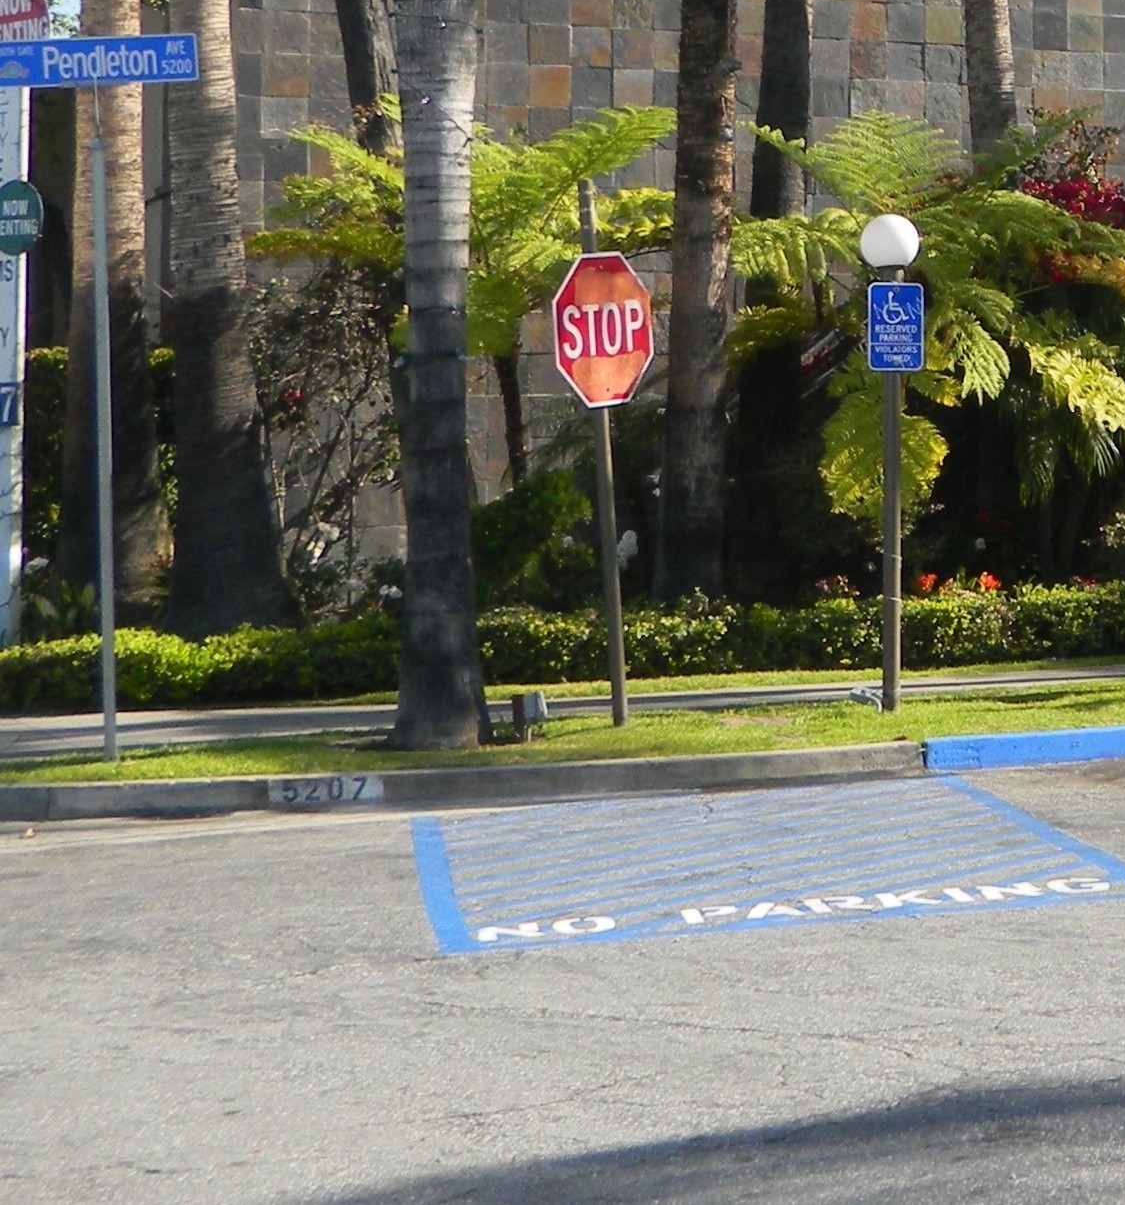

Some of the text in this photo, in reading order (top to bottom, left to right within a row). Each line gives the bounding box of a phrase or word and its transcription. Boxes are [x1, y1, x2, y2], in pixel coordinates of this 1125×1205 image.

[165, 40, 186, 56] AVE
[42, 44, 158, 80] Pendleton
[161, 59, 193, 75] 5200
[3, 199, 28, 216] NOW
[562, 298, 644, 359] STOP
[875, 324, 918, 334] RESERVED
[879, 334, 913, 343] PARKING
[875, 346, 918, 354] VIOLATORS
[883, 354, 911, 363] TOWED
[282, 776, 368, 802] 5207
[477, 877, 1111, 941] NO PARKING
